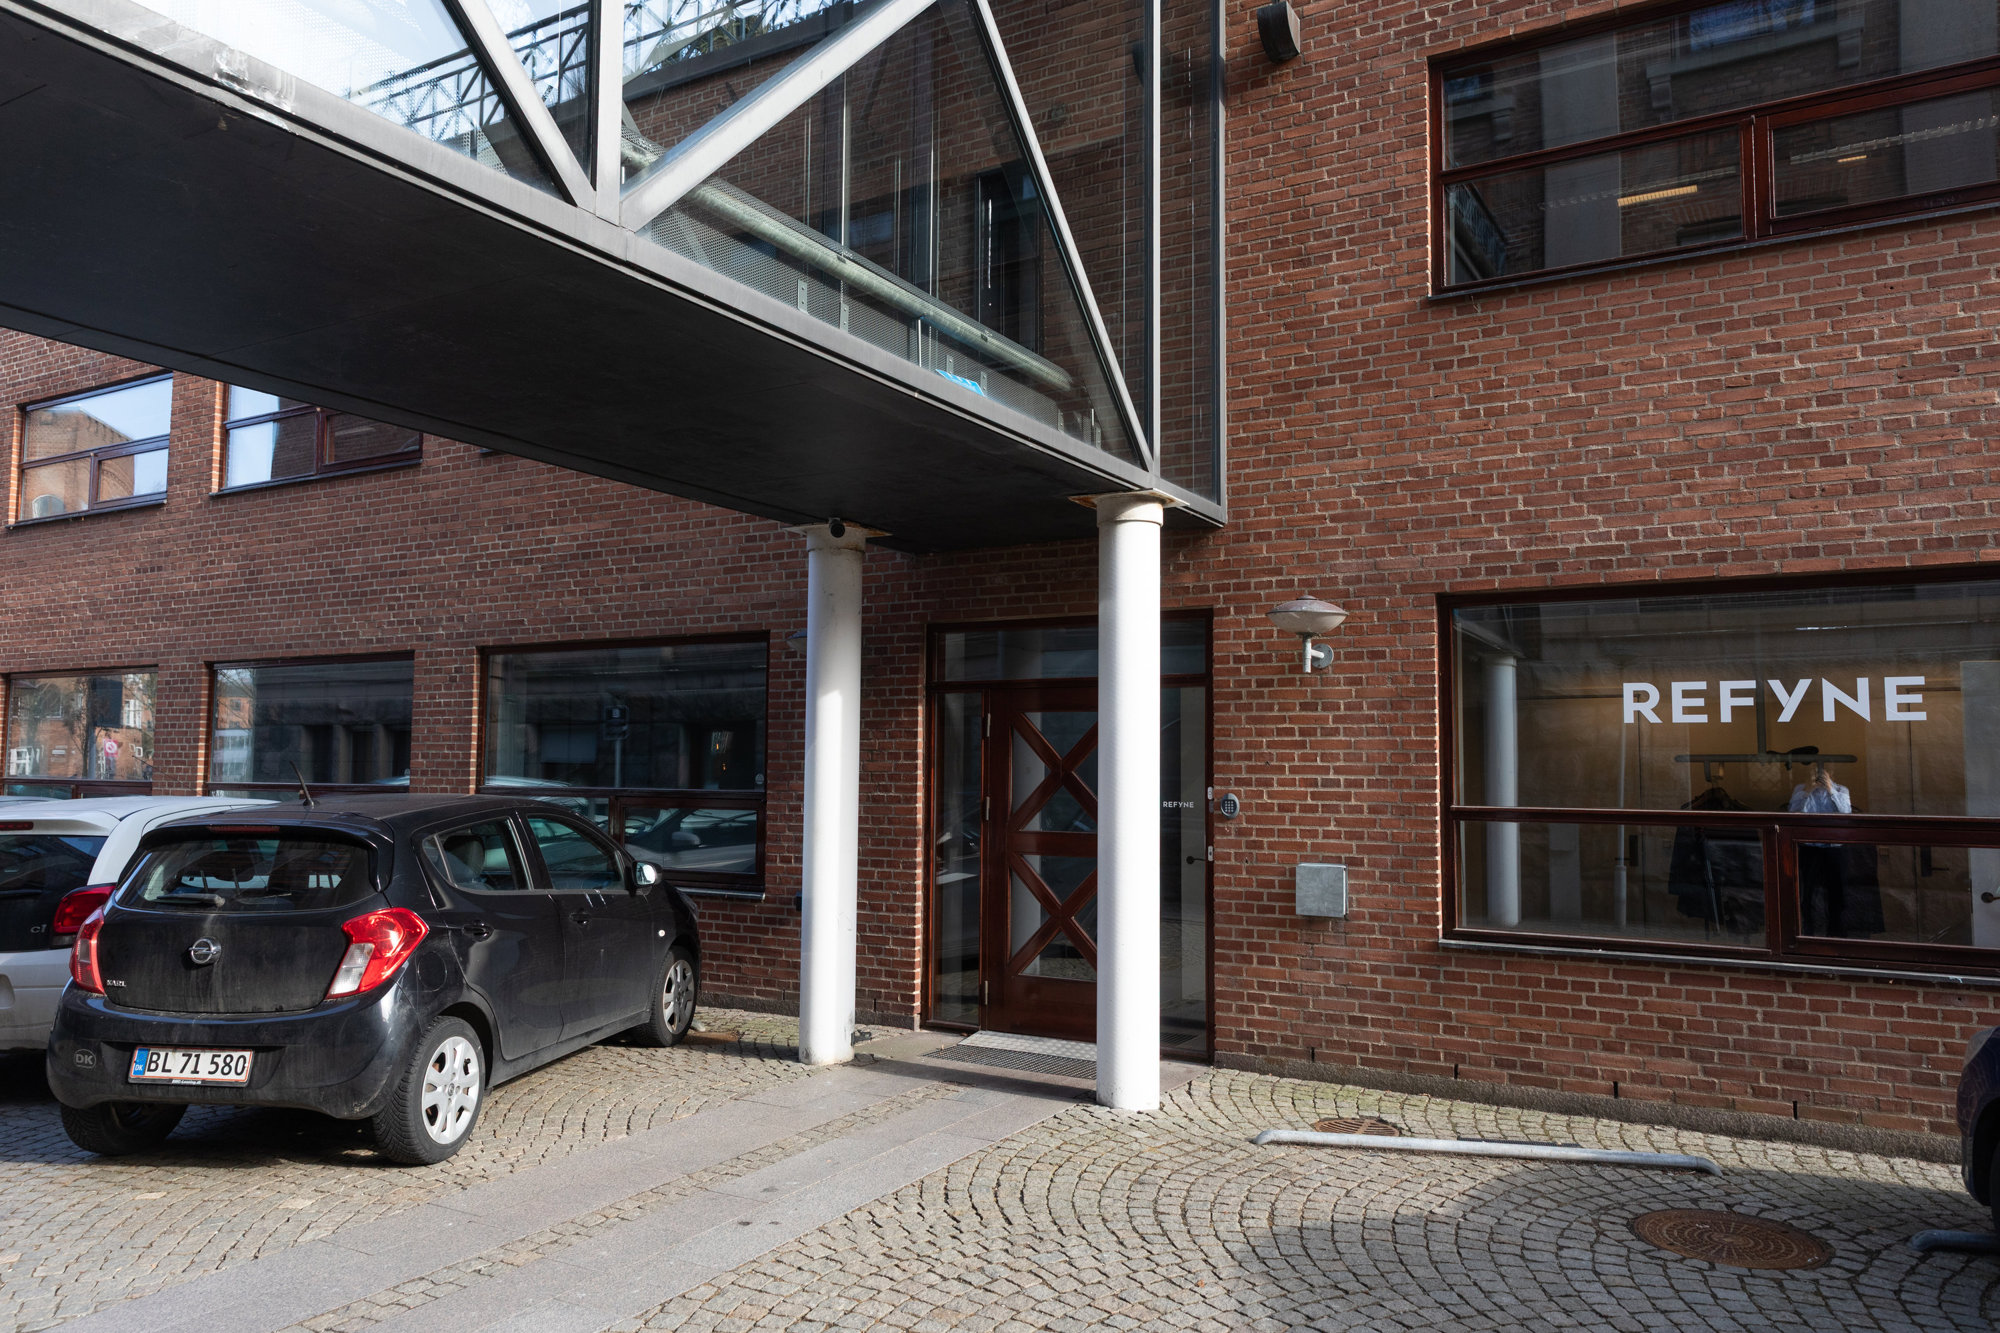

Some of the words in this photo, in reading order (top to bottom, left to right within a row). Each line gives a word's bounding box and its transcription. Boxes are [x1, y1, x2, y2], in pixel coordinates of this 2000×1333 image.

[1623, 676, 1927, 723] REFYNE
[75, 1053, 94, 1065] DK
[147, 1052, 172, 1073] BL
[179, 1053, 200, 1075] 71
[207, 1053, 247, 1076] 580
